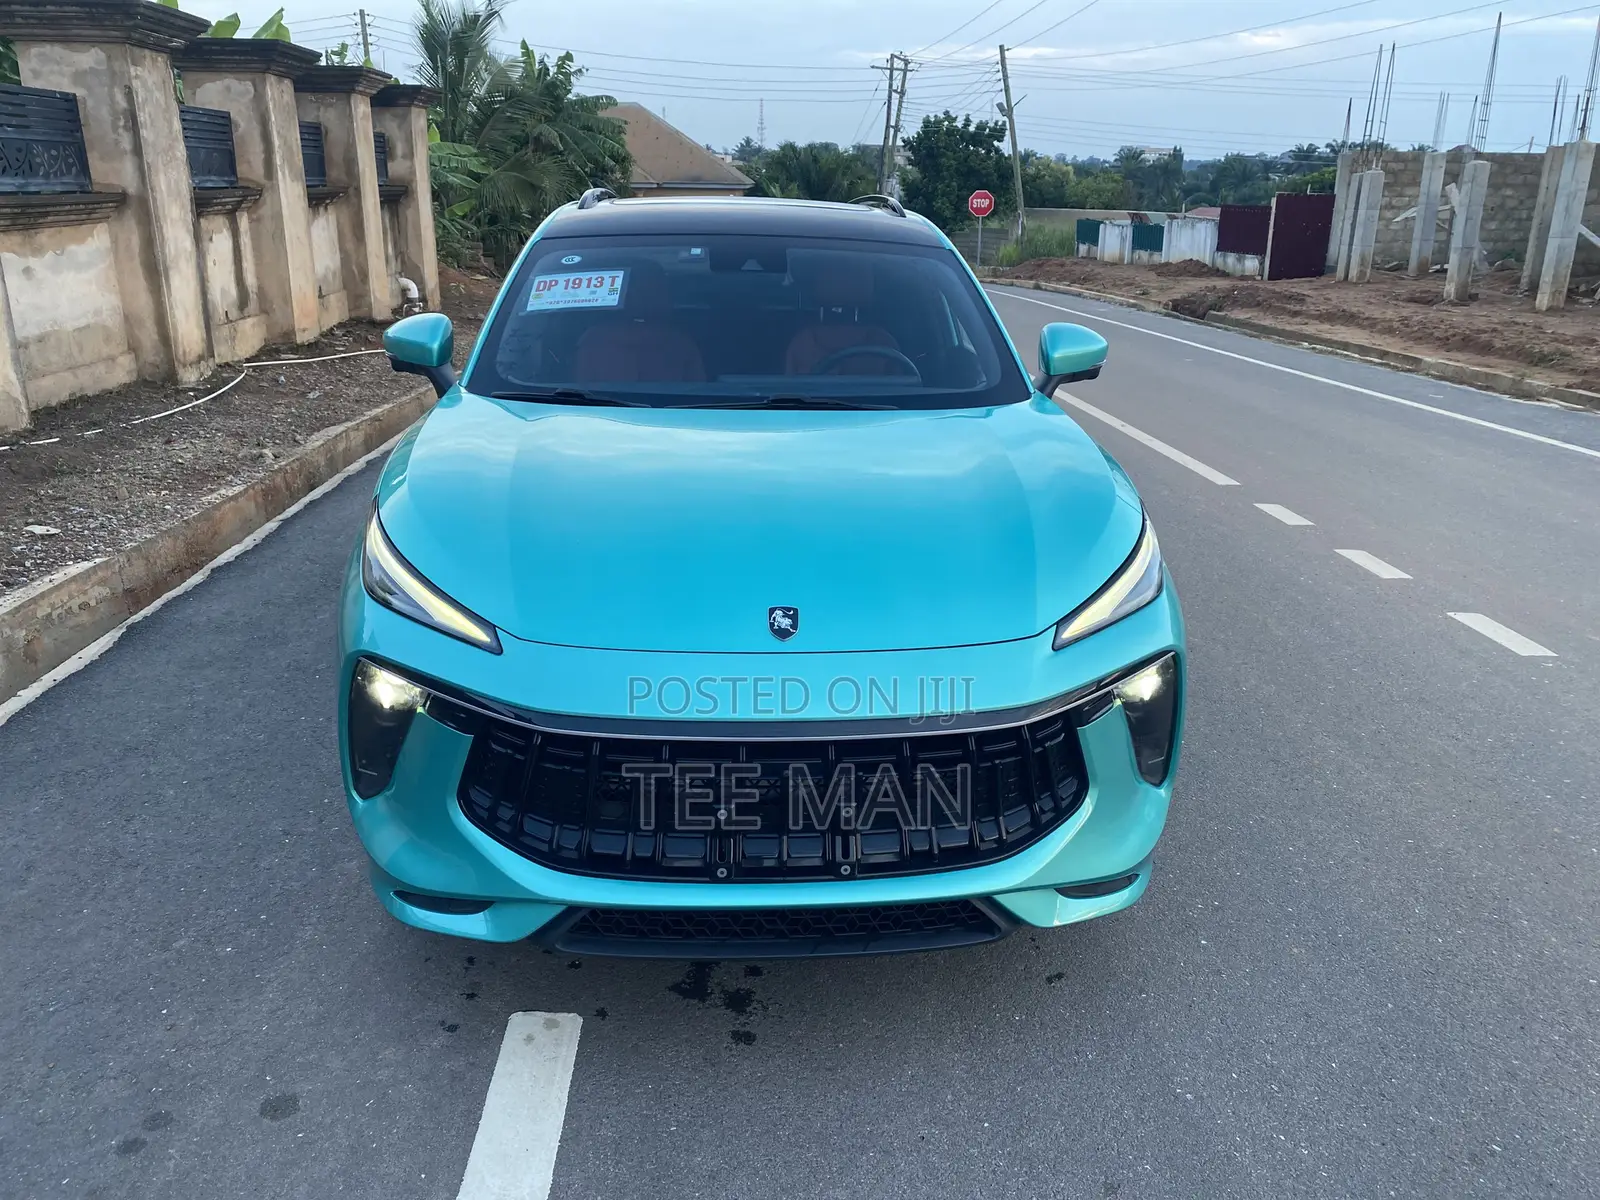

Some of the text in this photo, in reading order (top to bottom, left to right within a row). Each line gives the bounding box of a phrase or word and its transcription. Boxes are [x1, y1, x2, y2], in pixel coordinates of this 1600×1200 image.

[972, 198, 990, 208] STOP
[535, 276, 620, 292] DP 1913 T
